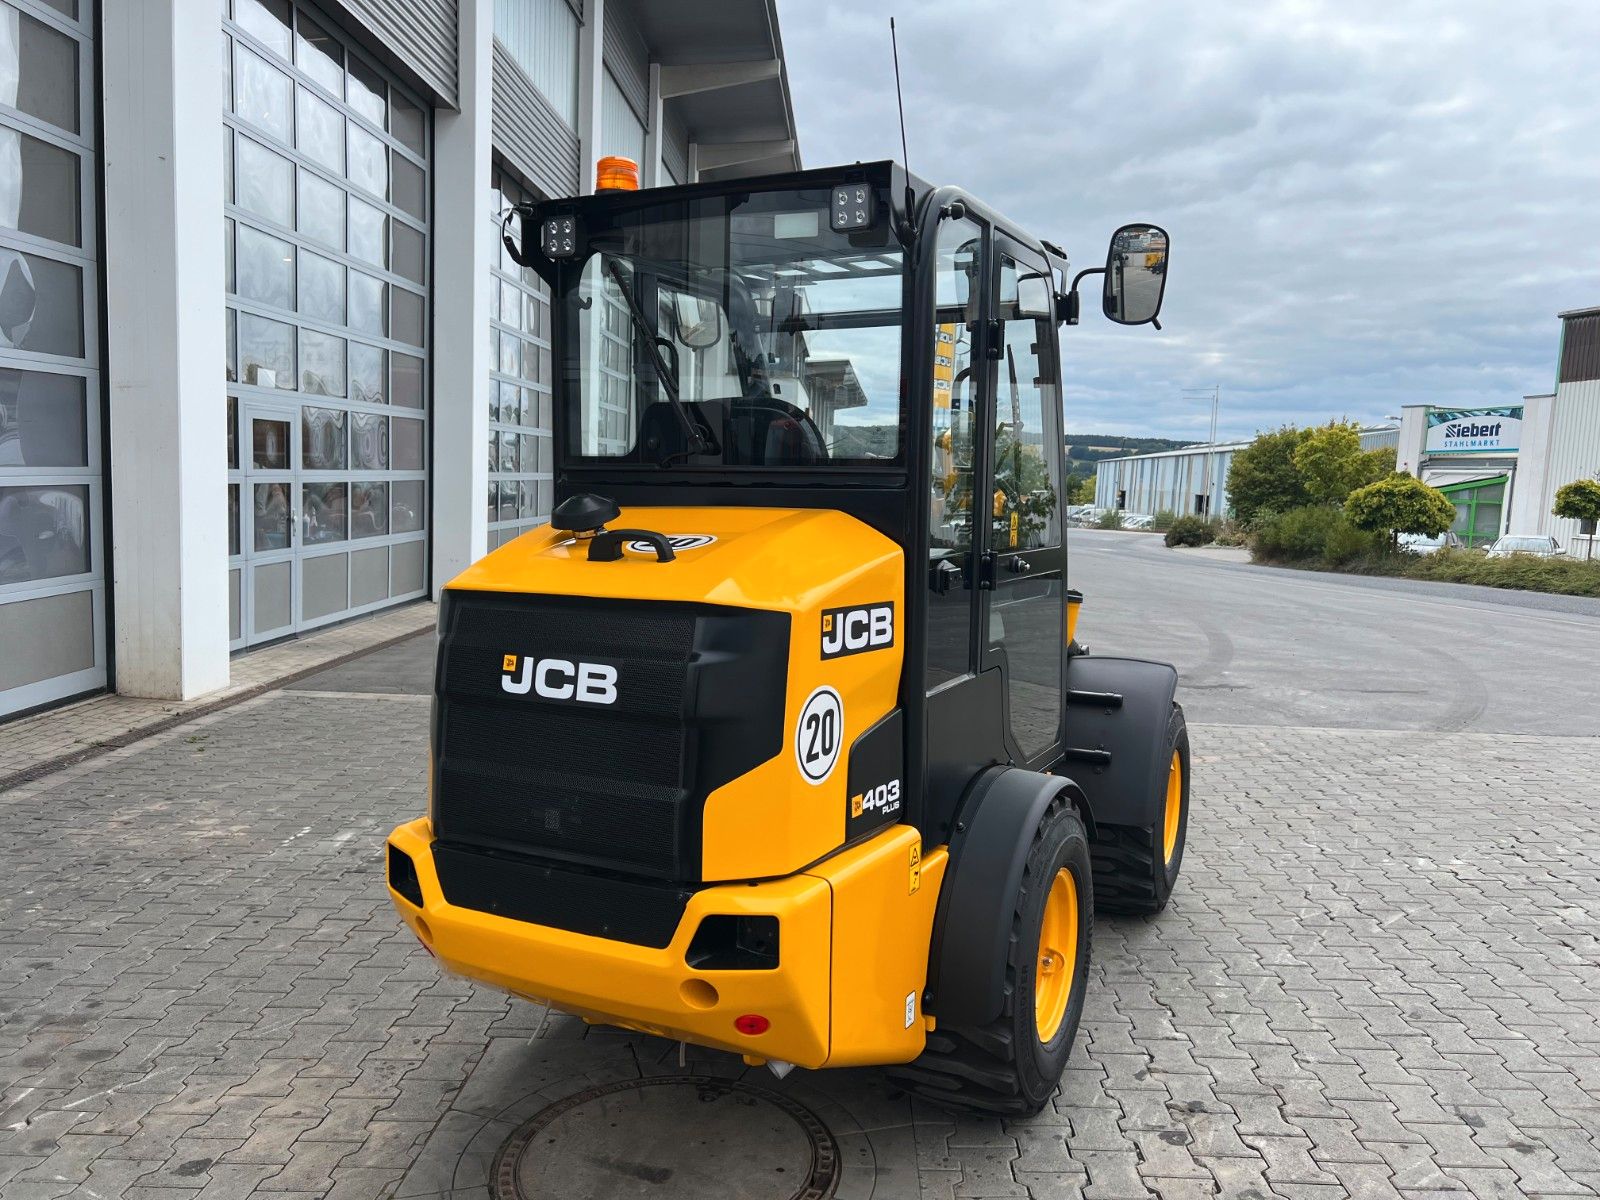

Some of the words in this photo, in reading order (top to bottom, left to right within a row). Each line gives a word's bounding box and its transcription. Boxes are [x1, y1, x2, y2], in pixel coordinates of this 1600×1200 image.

[1444, 440, 1500, 448] STAHLMARKT
[1445, 422, 1502, 438] Siebert
[822, 607, 893, 654] JCB
[501, 656, 618, 705] JCB
[806, 708, 835, 764] 20
[863, 779, 900, 811] 403
[882, 801, 900, 815] PLUS
